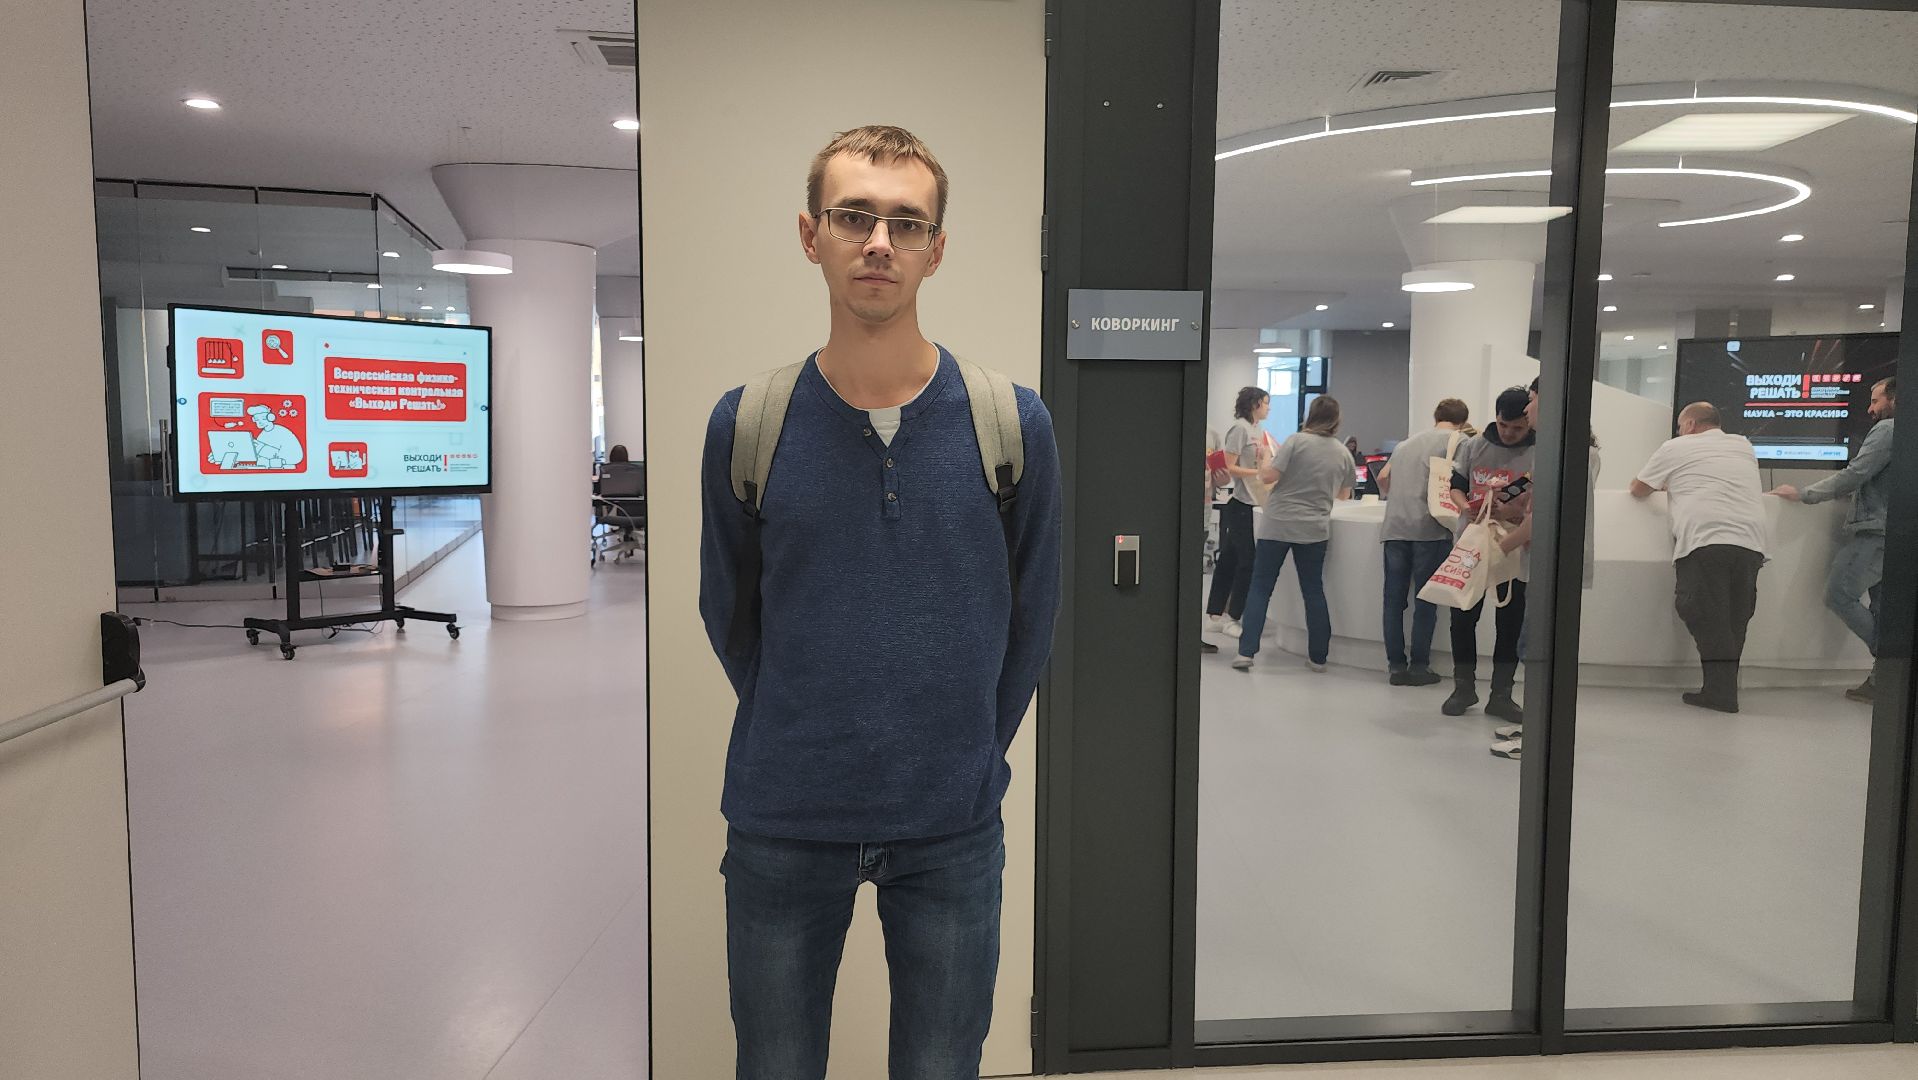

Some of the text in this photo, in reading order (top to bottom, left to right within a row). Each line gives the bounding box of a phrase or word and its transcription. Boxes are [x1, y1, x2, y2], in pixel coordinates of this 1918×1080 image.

[1091, 317, 1180, 332] КОВОРКИНГ
[333, 367, 415, 382] Всероссийская
[1745, 374, 1802, 387] ВЫХОДИ
[328, 384, 464, 398] техническая контрольная
[1749, 387, 1801, 399] РЕШАТЬ
[348, 397, 398, 410] «Выходи
[1743, 409, 1775, 418] НАУКА
[1784, 409, 1804, 418] ЭТО
[1804, 409, 1849, 418] КРАСИВО
[403, 454, 442, 463] ВЫХОДИ
[406, 464, 442, 473] РЕШАТЬ
